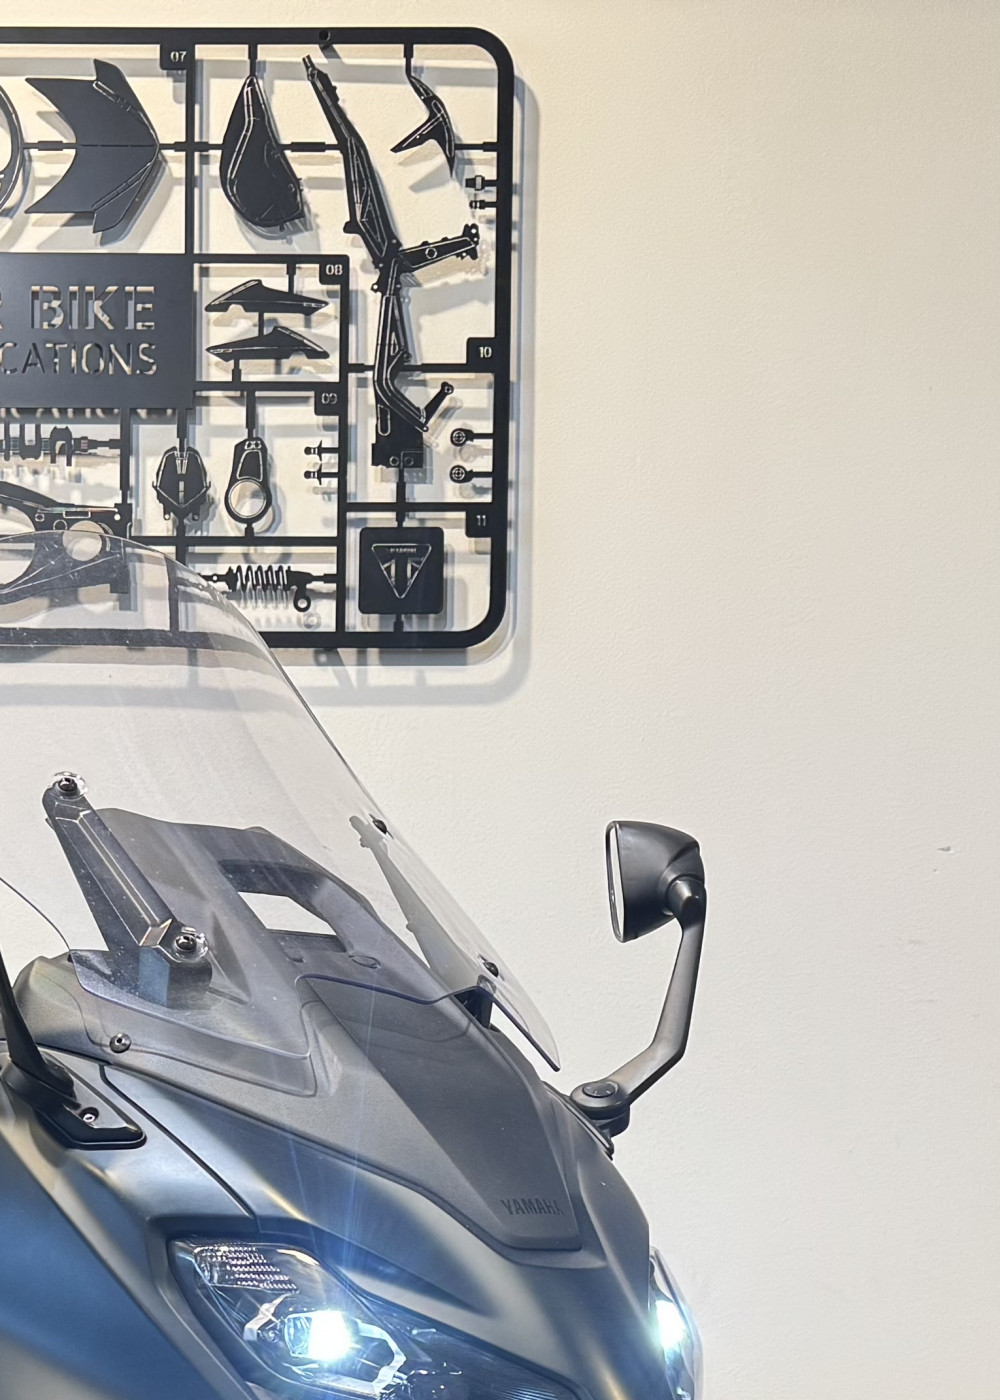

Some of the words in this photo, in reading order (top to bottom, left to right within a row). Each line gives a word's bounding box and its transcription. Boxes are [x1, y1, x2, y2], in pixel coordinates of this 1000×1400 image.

[170, 51, 187, 62] 07
[325, 264, 342, 275] 08
[31, 284, 156, 331] BIKE
[478, 346, 492, 358] 10
[321, 393, 338, 404] 09
[476, 515, 486, 526] 11
